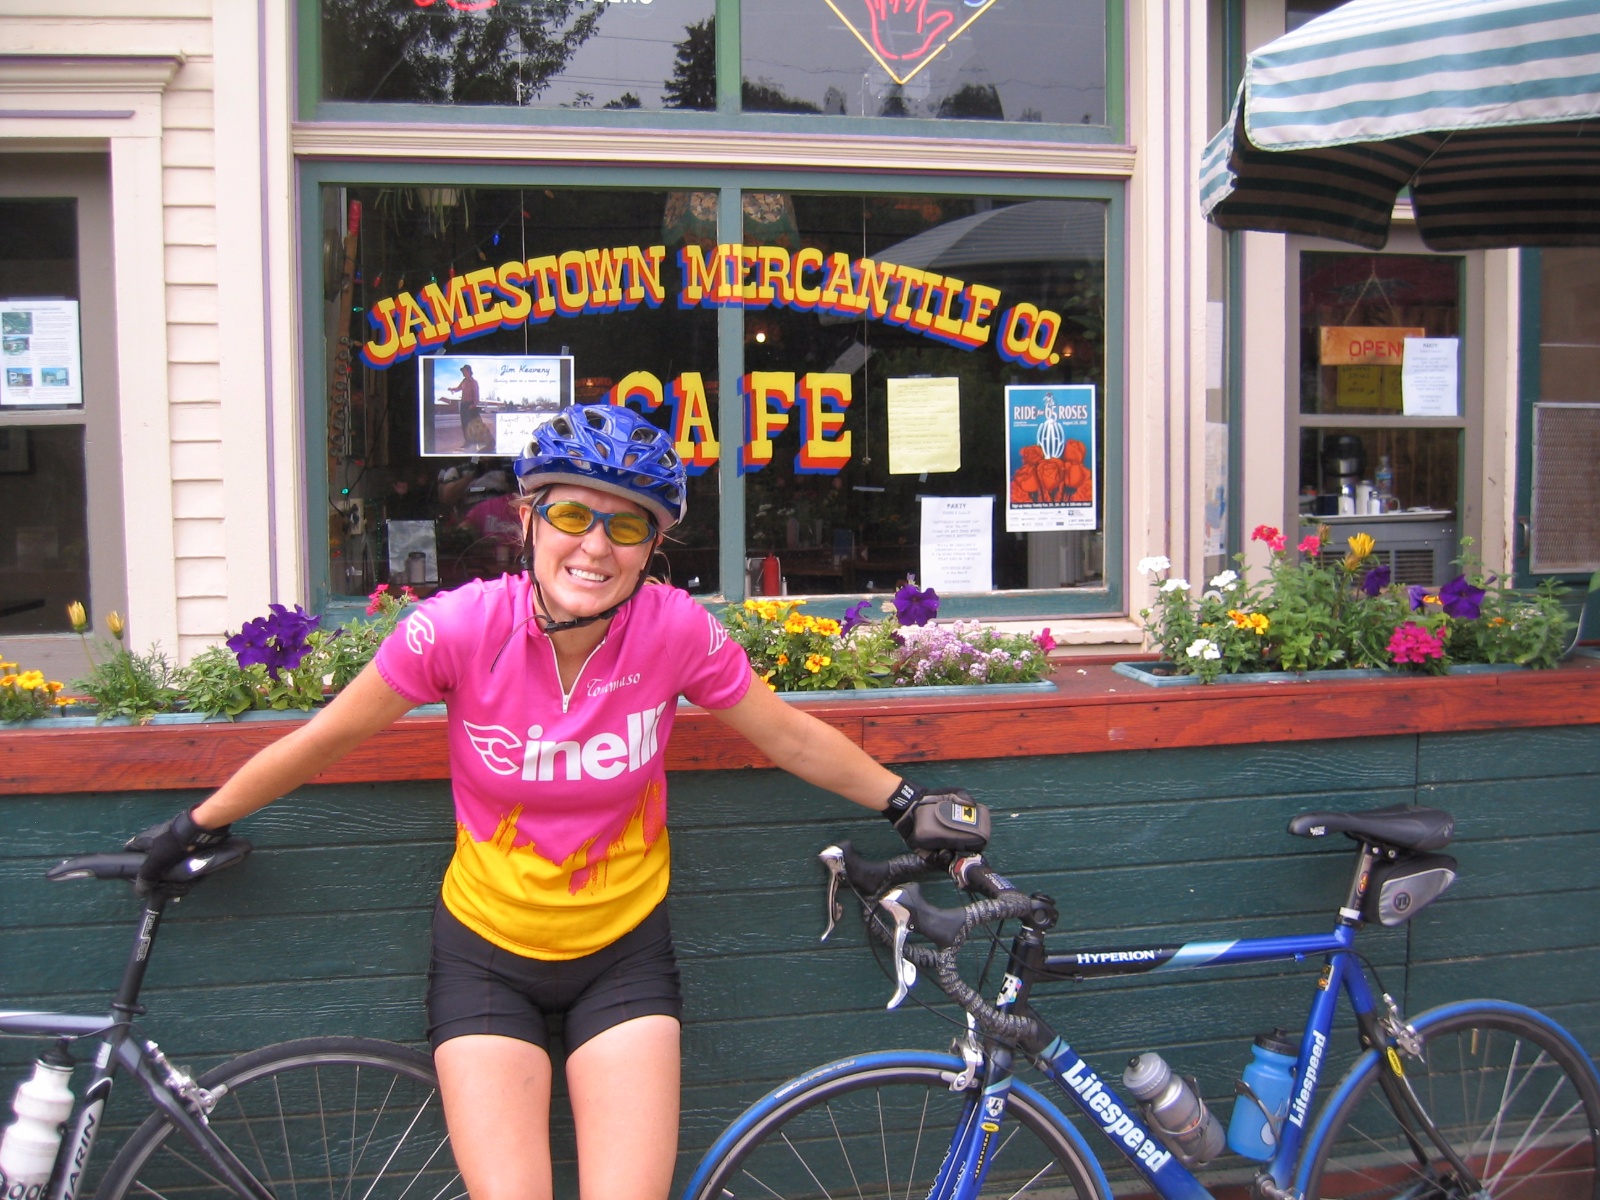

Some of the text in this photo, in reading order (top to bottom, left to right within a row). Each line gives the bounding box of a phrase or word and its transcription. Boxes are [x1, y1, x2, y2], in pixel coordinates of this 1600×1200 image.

[360, 243, 1062, 370] JAMESTOWN MERCANTILE CO.
[1349, 340, 1402, 358] OPEN
[500, 365, 516, 377] Jim
[1014, 405, 1037, 420] RIDE
[1045, 402, 1058, 421] 65
[1058, 404, 1088, 420] ROSES
[1076, 950, 1156, 965] HYPERION
[1288, 1029, 1326, 1130] Litespeed
[1061, 1058, 1173, 1174] Litespeed
